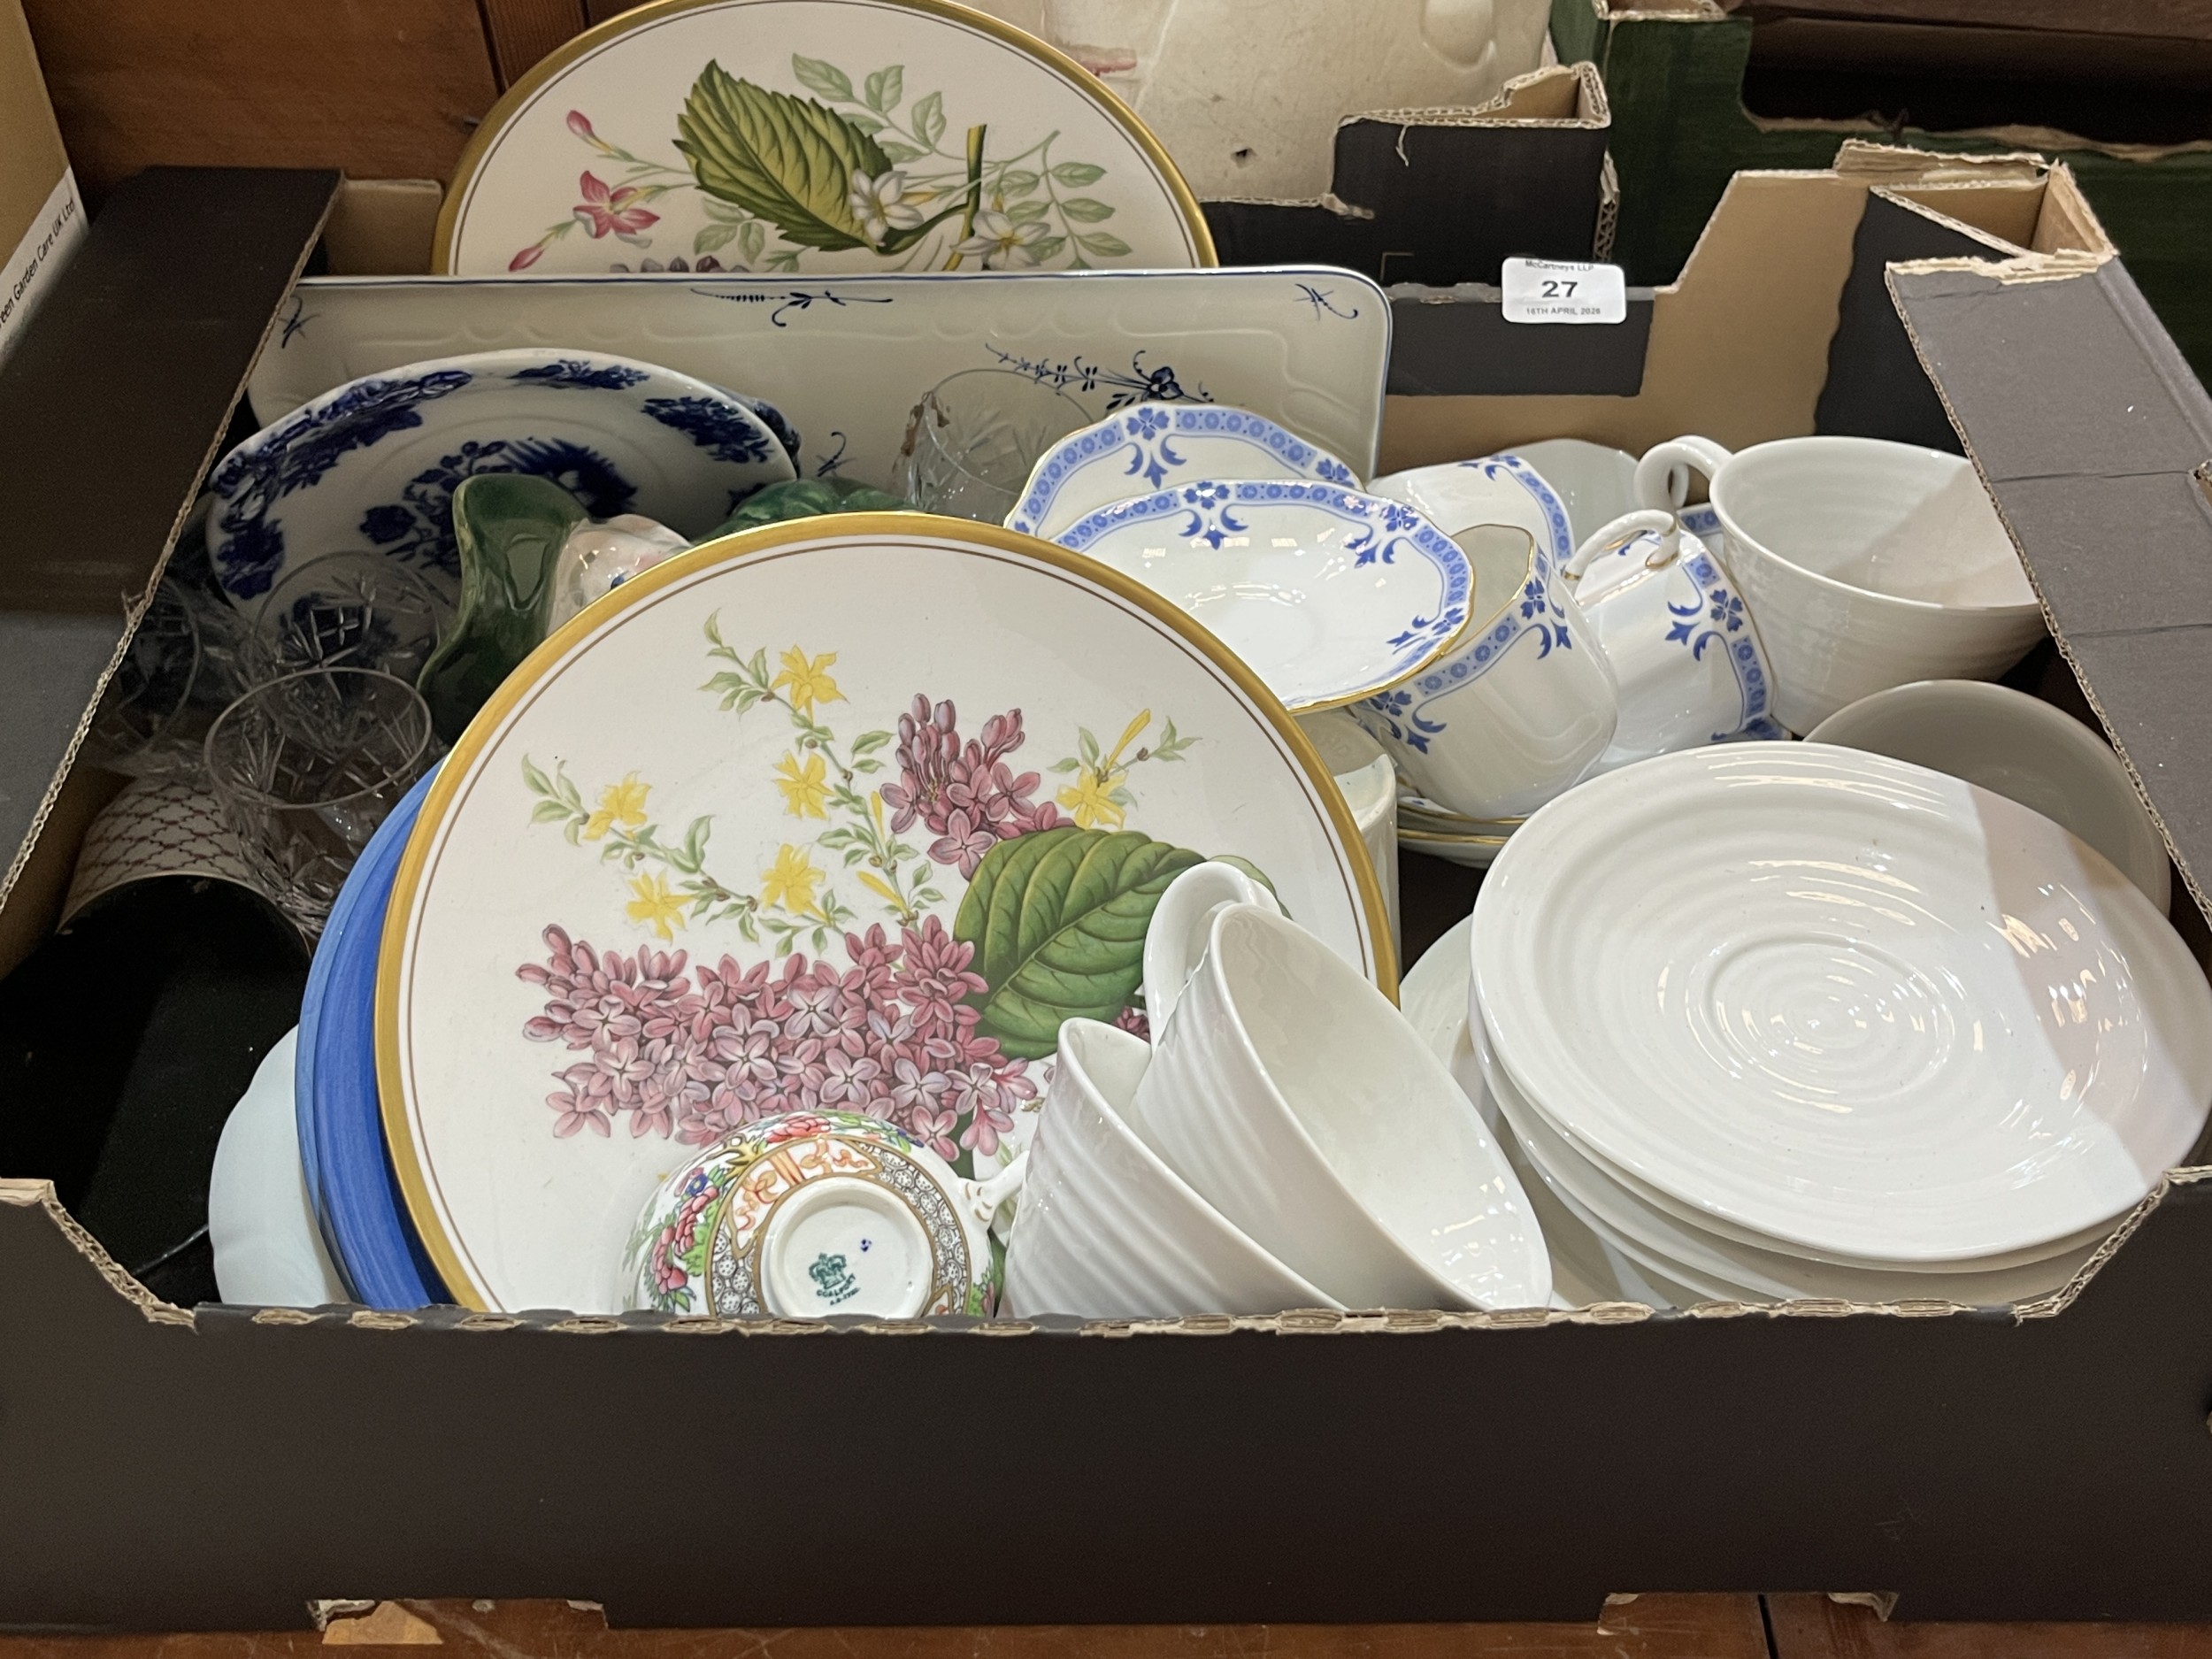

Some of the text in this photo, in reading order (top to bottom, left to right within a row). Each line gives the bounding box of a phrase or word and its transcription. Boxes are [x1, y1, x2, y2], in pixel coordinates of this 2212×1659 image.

[13, 258, 39, 302] Garden
[37, 233, 54, 262] Care
[52, 214, 63, 238] UK
[62, 196, 76, 222] Ltd
[1525, 259, 1594, 273] McCartneys LLP
[1541, 280, 1578, 298] 27
[1550, 306, 1578, 316] APRIL
[1580, 307, 1601, 316] 2026
